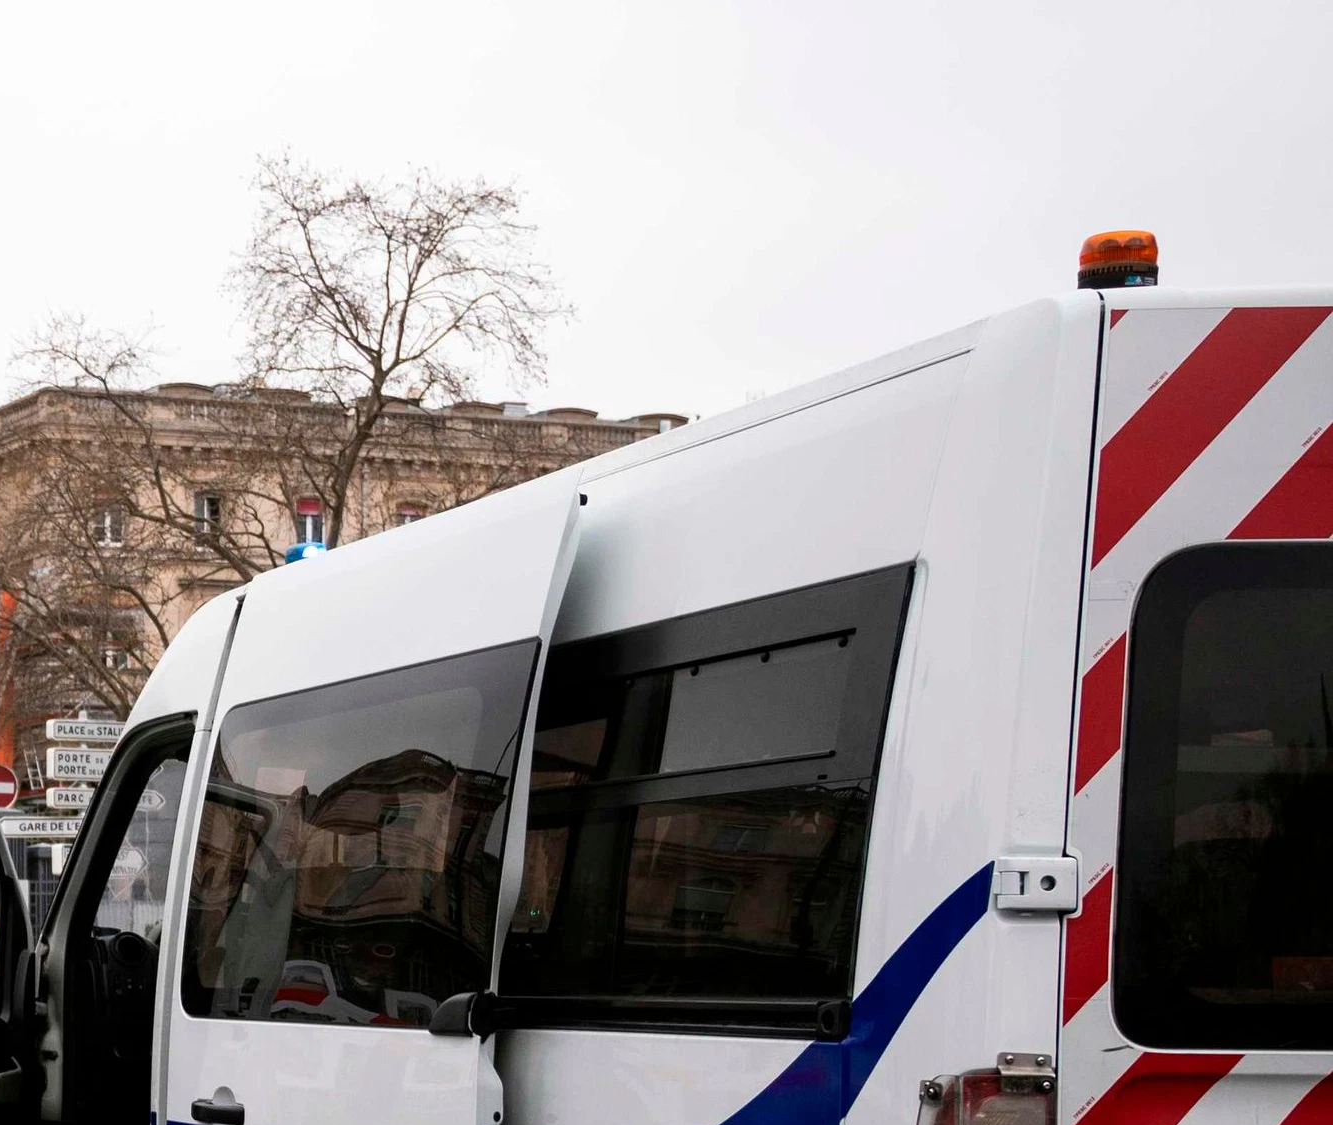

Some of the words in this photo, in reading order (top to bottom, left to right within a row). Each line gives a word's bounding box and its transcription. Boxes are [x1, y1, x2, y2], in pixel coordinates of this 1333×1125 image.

[57, 725, 85, 735] PLACE
[58, 754, 91, 764] PORTE
[58, 766, 87, 776] PORTE
[58, 794, 84, 803] PARC
[19, 822, 47, 832] GARE
[50, 822, 64, 831] DE
